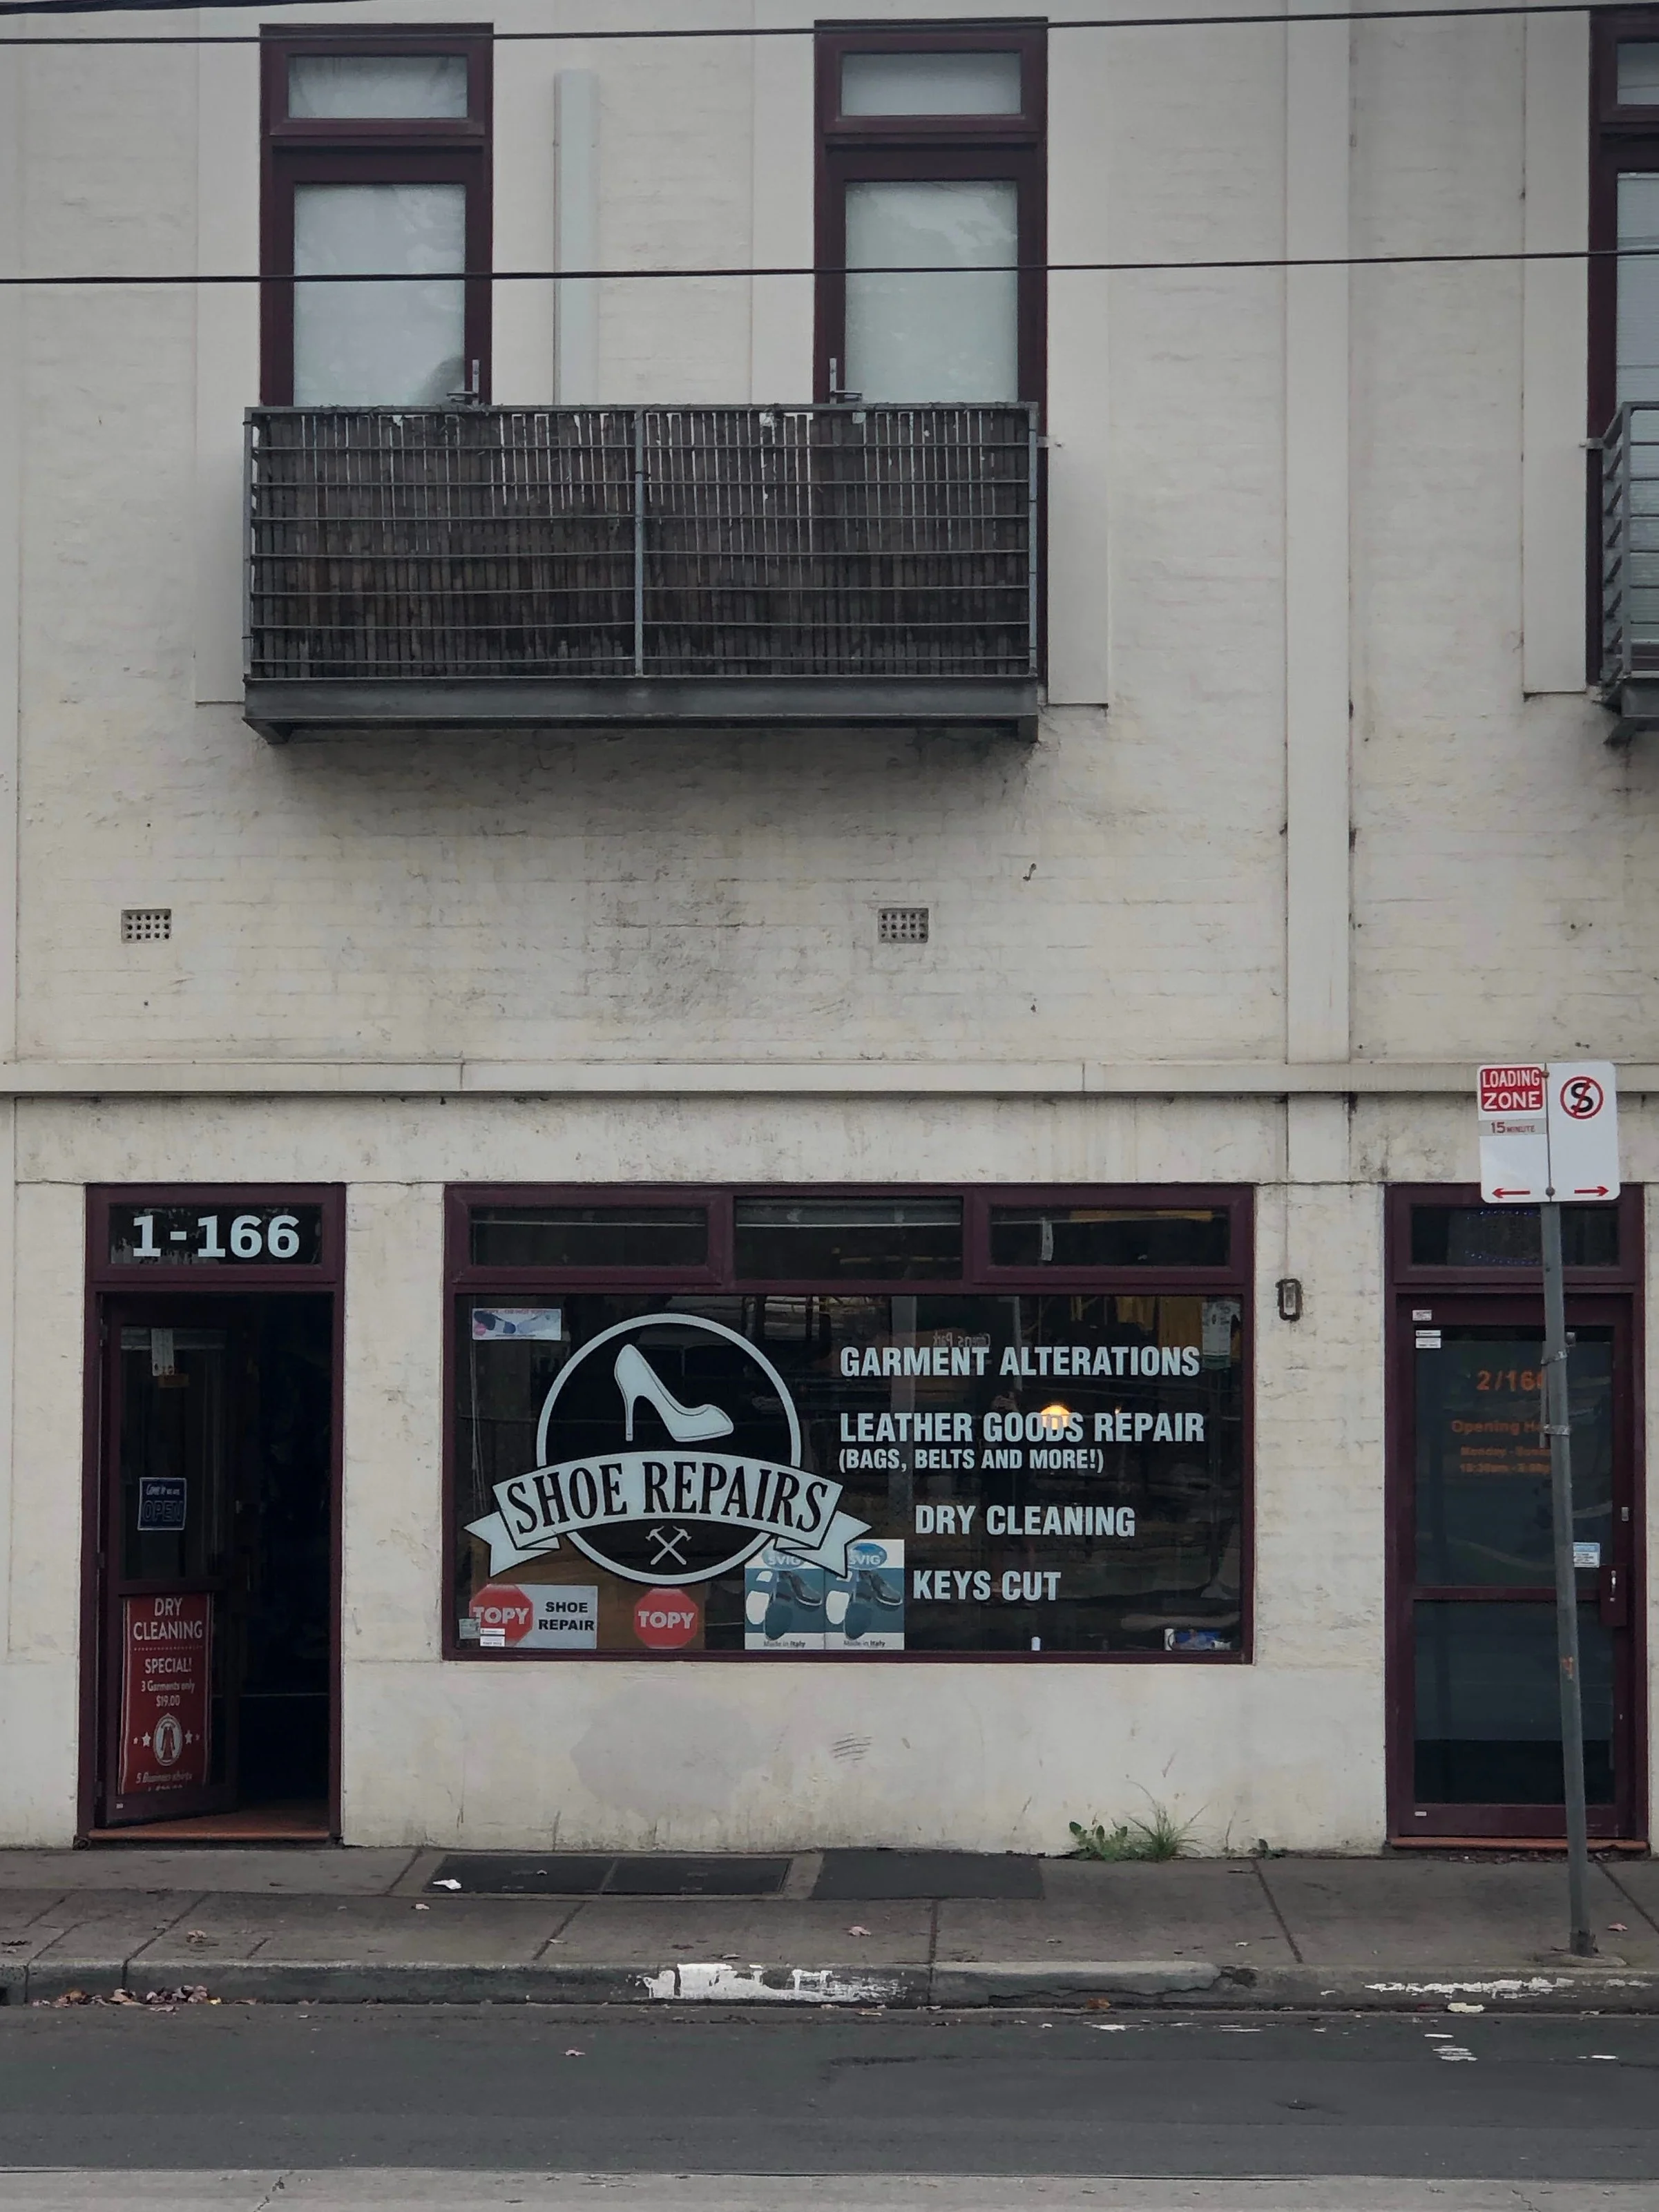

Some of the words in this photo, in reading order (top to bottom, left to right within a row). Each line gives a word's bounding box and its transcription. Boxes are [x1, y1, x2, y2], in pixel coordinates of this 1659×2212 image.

[1483, 1068, 1540, 1088] LOADING
[1484, 1090, 1541, 1109] ZONE
[1490, 1122, 1506, 1133] 15
[133, 1214, 300, 1258] 1-166
[840, 1347, 990, 1377] GARMENT
[999, 1346, 1200, 1376] ALTERATIONS
[840, 1412, 973, 1442] LEATHER
[983, 1412, 1084, 1442] GOODS
[1094, 1412, 1205, 1442] REPAIR
[1452, 1419, 1519, 1436] Opening
[838, 1449, 907, 1474] (BAGS,
[914, 1449, 975, 1470] BELTS
[981, 1449, 1023, 1470] AND
[1029, 1449, 1105, 1473] MORE!)
[506, 1462, 627, 1535] SHOE
[643, 1461, 829, 1533] REPAIRS
[142, 1500, 184, 1522] OPEN
[915, 1505, 976, 1535] DRY
[986, 1505, 1135, 1537] CLEANING
[767, 1555, 801, 1565] SVIG
[912, 1570, 992, 1601] KEYS
[1001, 1570, 1062, 1601] CUT
[154, 1597, 182, 1617] DRY
[472, 1606, 530, 1625] TOPY
[545, 1601, 588, 1613] SHOE
[538, 1618, 595, 1631] REPAIR
[637, 1609, 695, 1629] TOPY
[133, 1621, 203, 1641] CLEANING
[144, 1657, 192, 1674] SPECIAL!
[141, 1680, 146, 1692] 3
